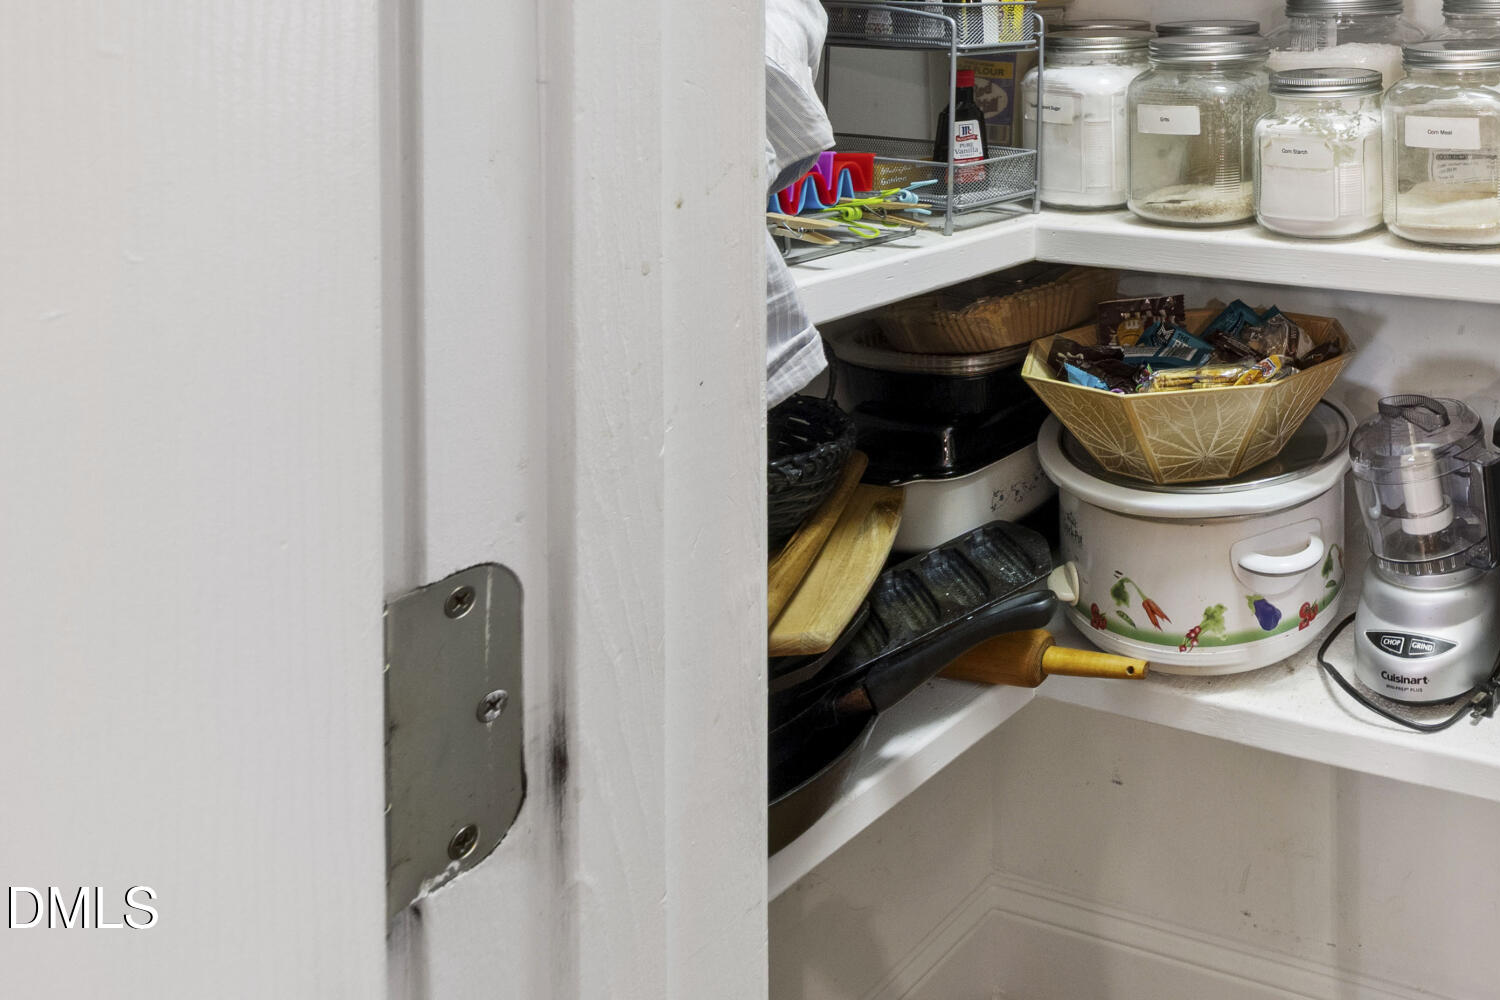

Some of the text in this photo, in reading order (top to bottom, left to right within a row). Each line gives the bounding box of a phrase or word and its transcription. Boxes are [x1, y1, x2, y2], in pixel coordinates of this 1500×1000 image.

[1383, 638, 1433, 651] CHOP GRIND
[1381, 670, 1428, 684] Cuisinart
